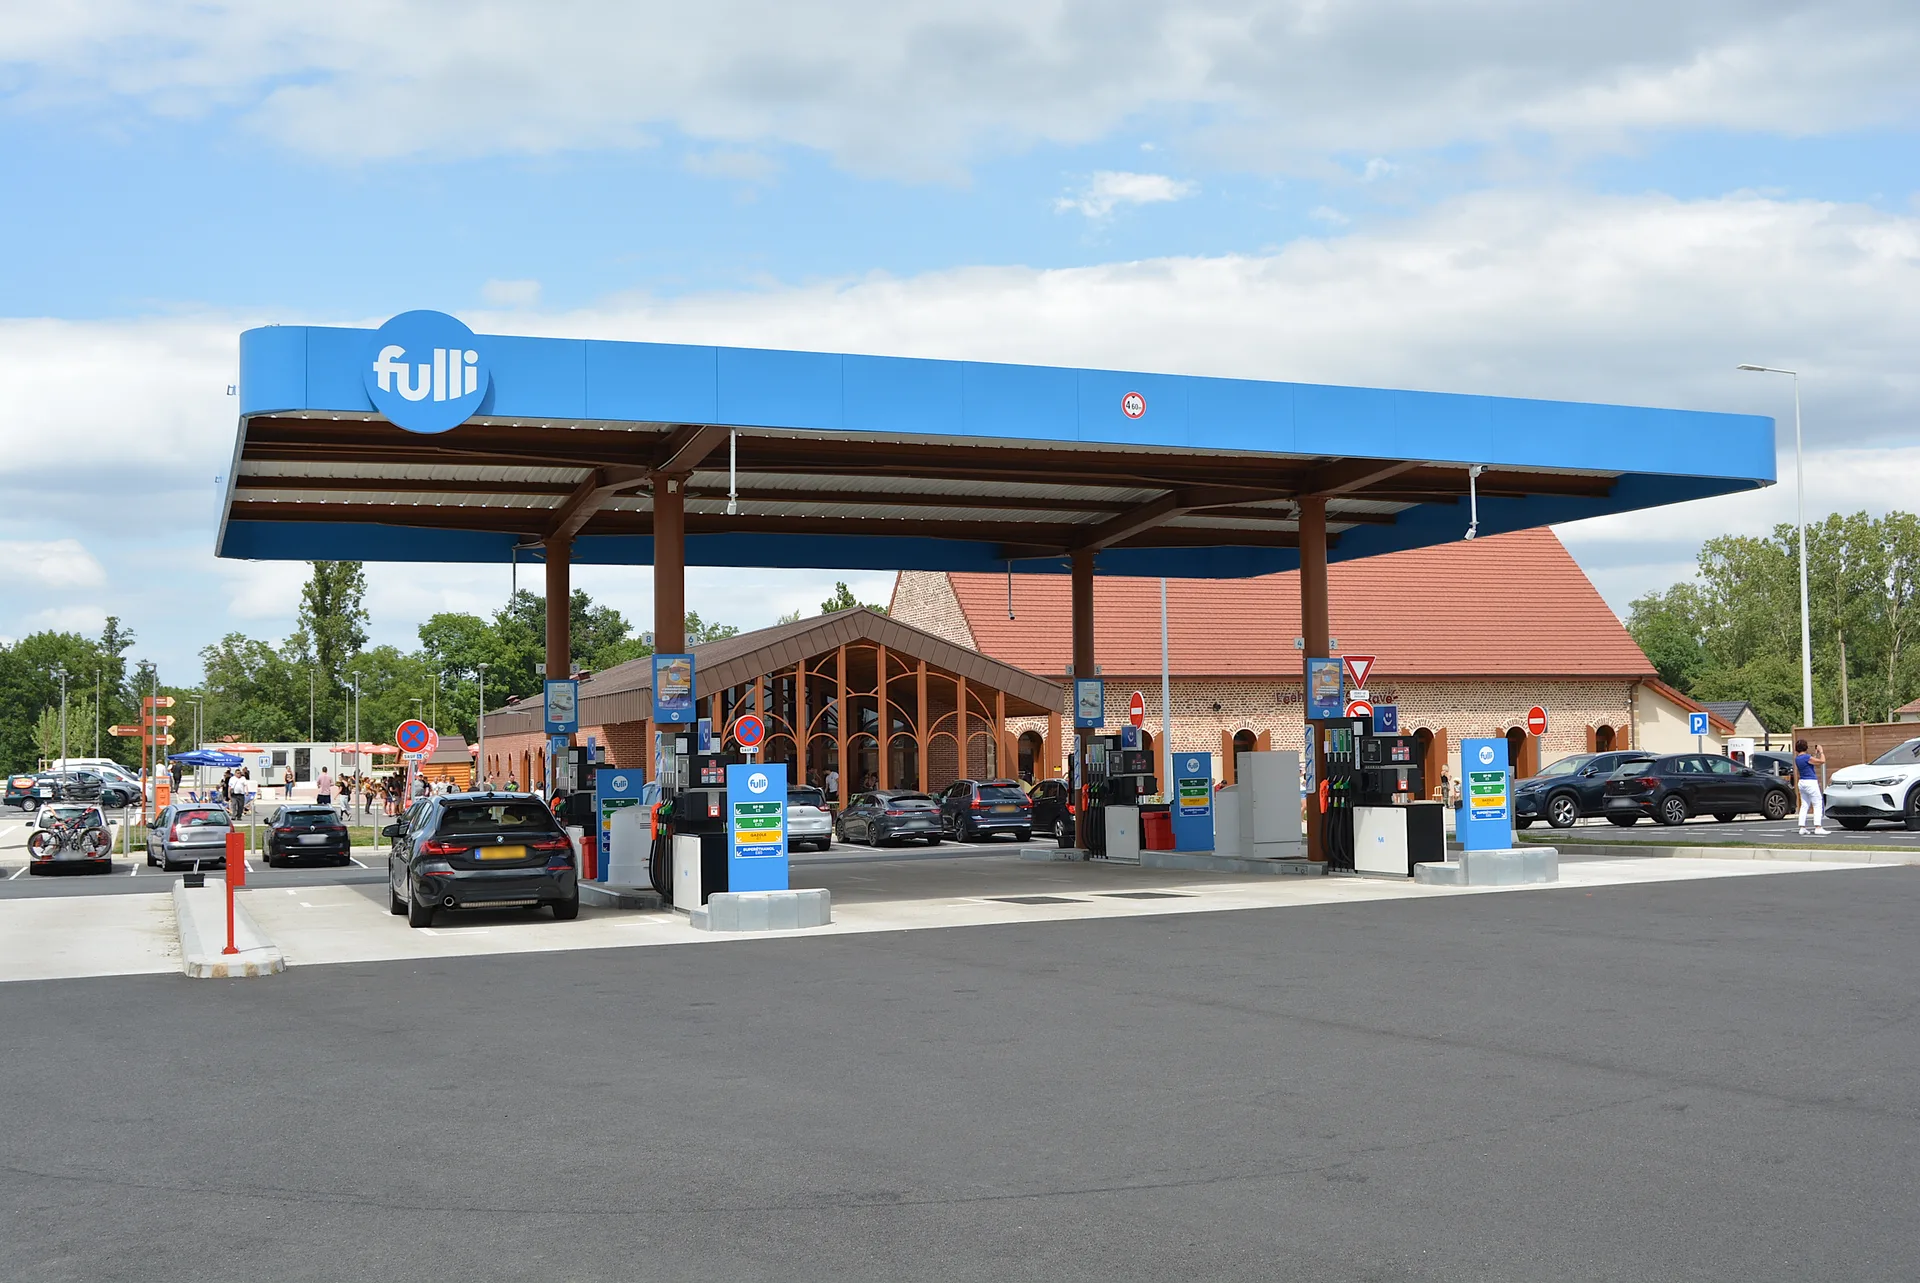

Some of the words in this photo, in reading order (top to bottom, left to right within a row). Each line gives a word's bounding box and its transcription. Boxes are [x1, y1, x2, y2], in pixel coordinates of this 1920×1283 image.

[373, 344, 479, 402] fulli
[646, 635, 652, 643] 8
[688, 635, 694, 643] 6
[1694, 717, 1703, 731] P
[1480, 751, 1493, 760] fulli
[750, 779, 766, 788] fulli
